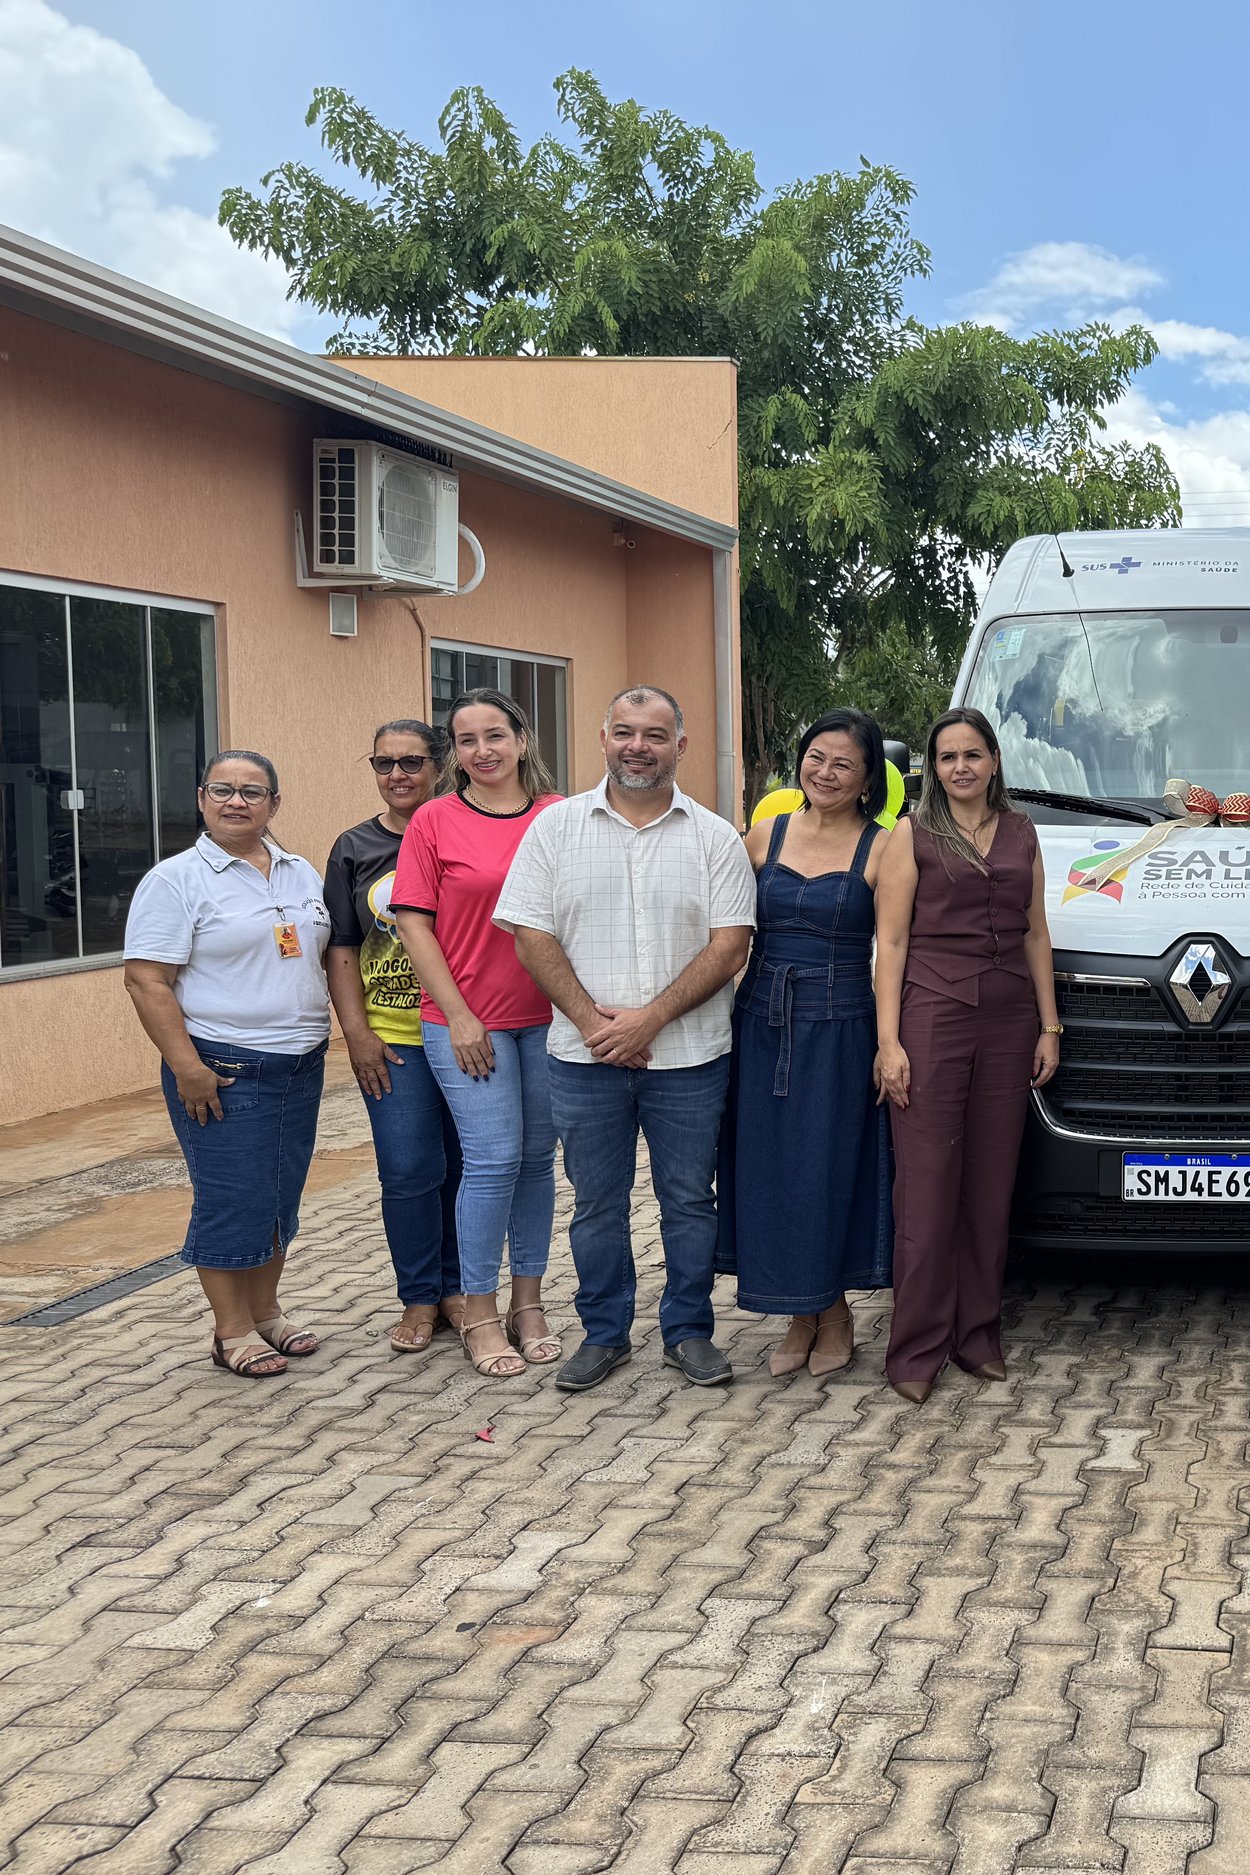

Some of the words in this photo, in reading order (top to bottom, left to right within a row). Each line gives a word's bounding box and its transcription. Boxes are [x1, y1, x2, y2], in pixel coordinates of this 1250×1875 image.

[1081, 563, 1108, 572] SUS
[1142, 868, 1213, 881] SEM
[1140, 881, 1180, 890] Rede
[1185, 881, 1204, 890] de
[1152, 891, 1207, 899] Pessoa
[1186, 1158, 1211, 1166] BRASIL
[1125, 1188, 1135, 1198] BR
